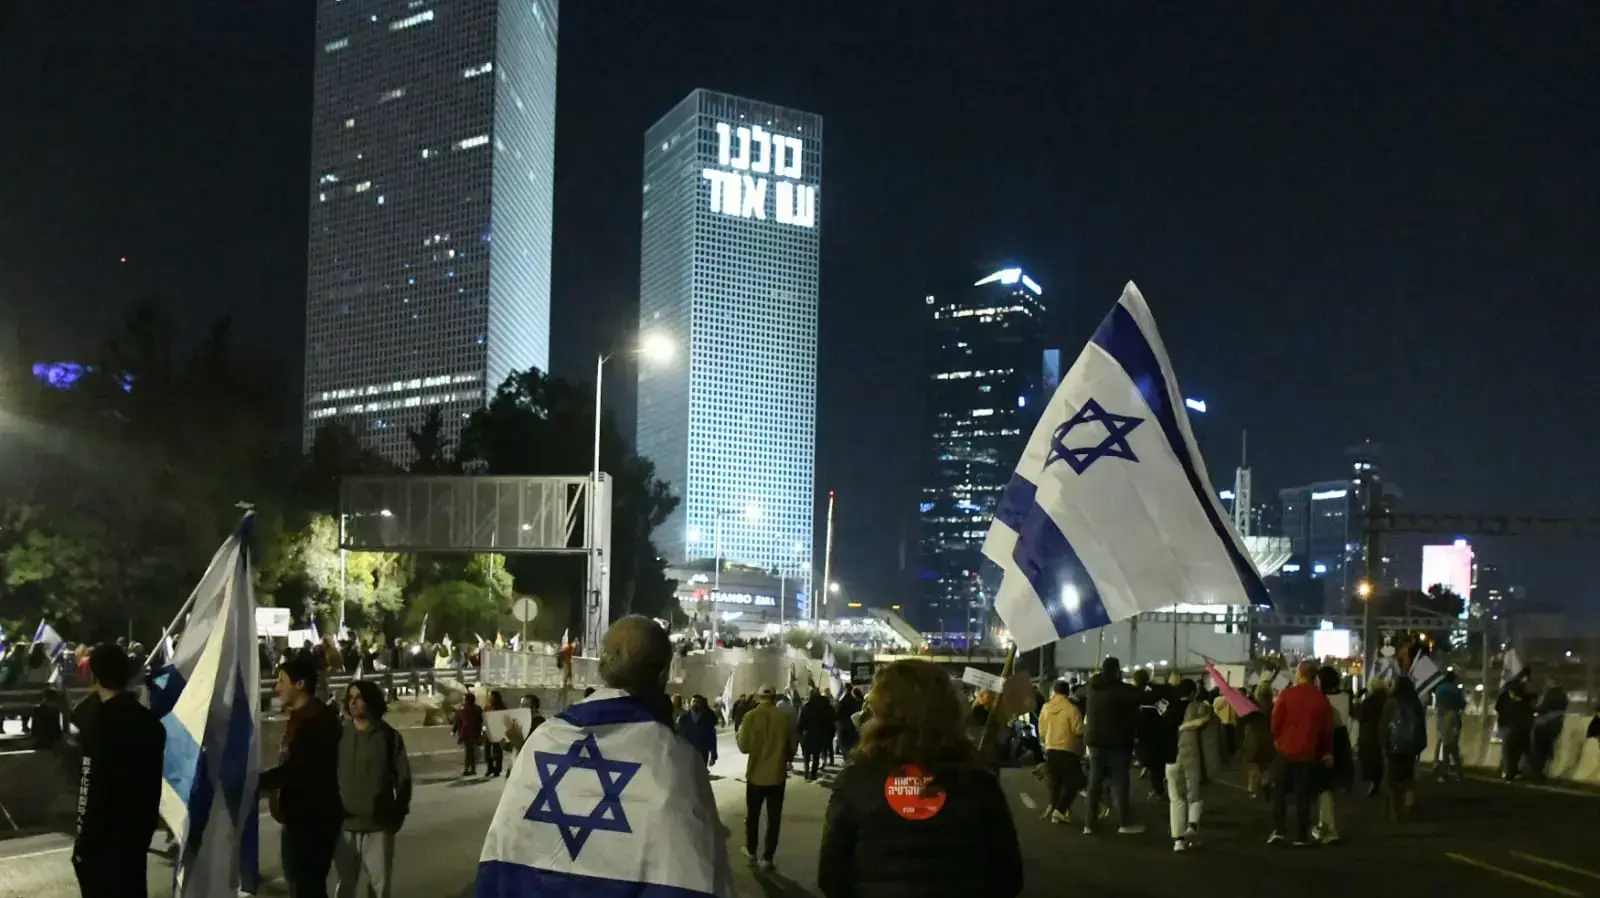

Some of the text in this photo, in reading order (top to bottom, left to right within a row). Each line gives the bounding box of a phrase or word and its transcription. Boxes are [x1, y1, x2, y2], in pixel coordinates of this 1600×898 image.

[716, 121, 802, 179] כולנו
[702, 167, 815, 228] עם אחד
[710, 591, 752, 605] MANGO
